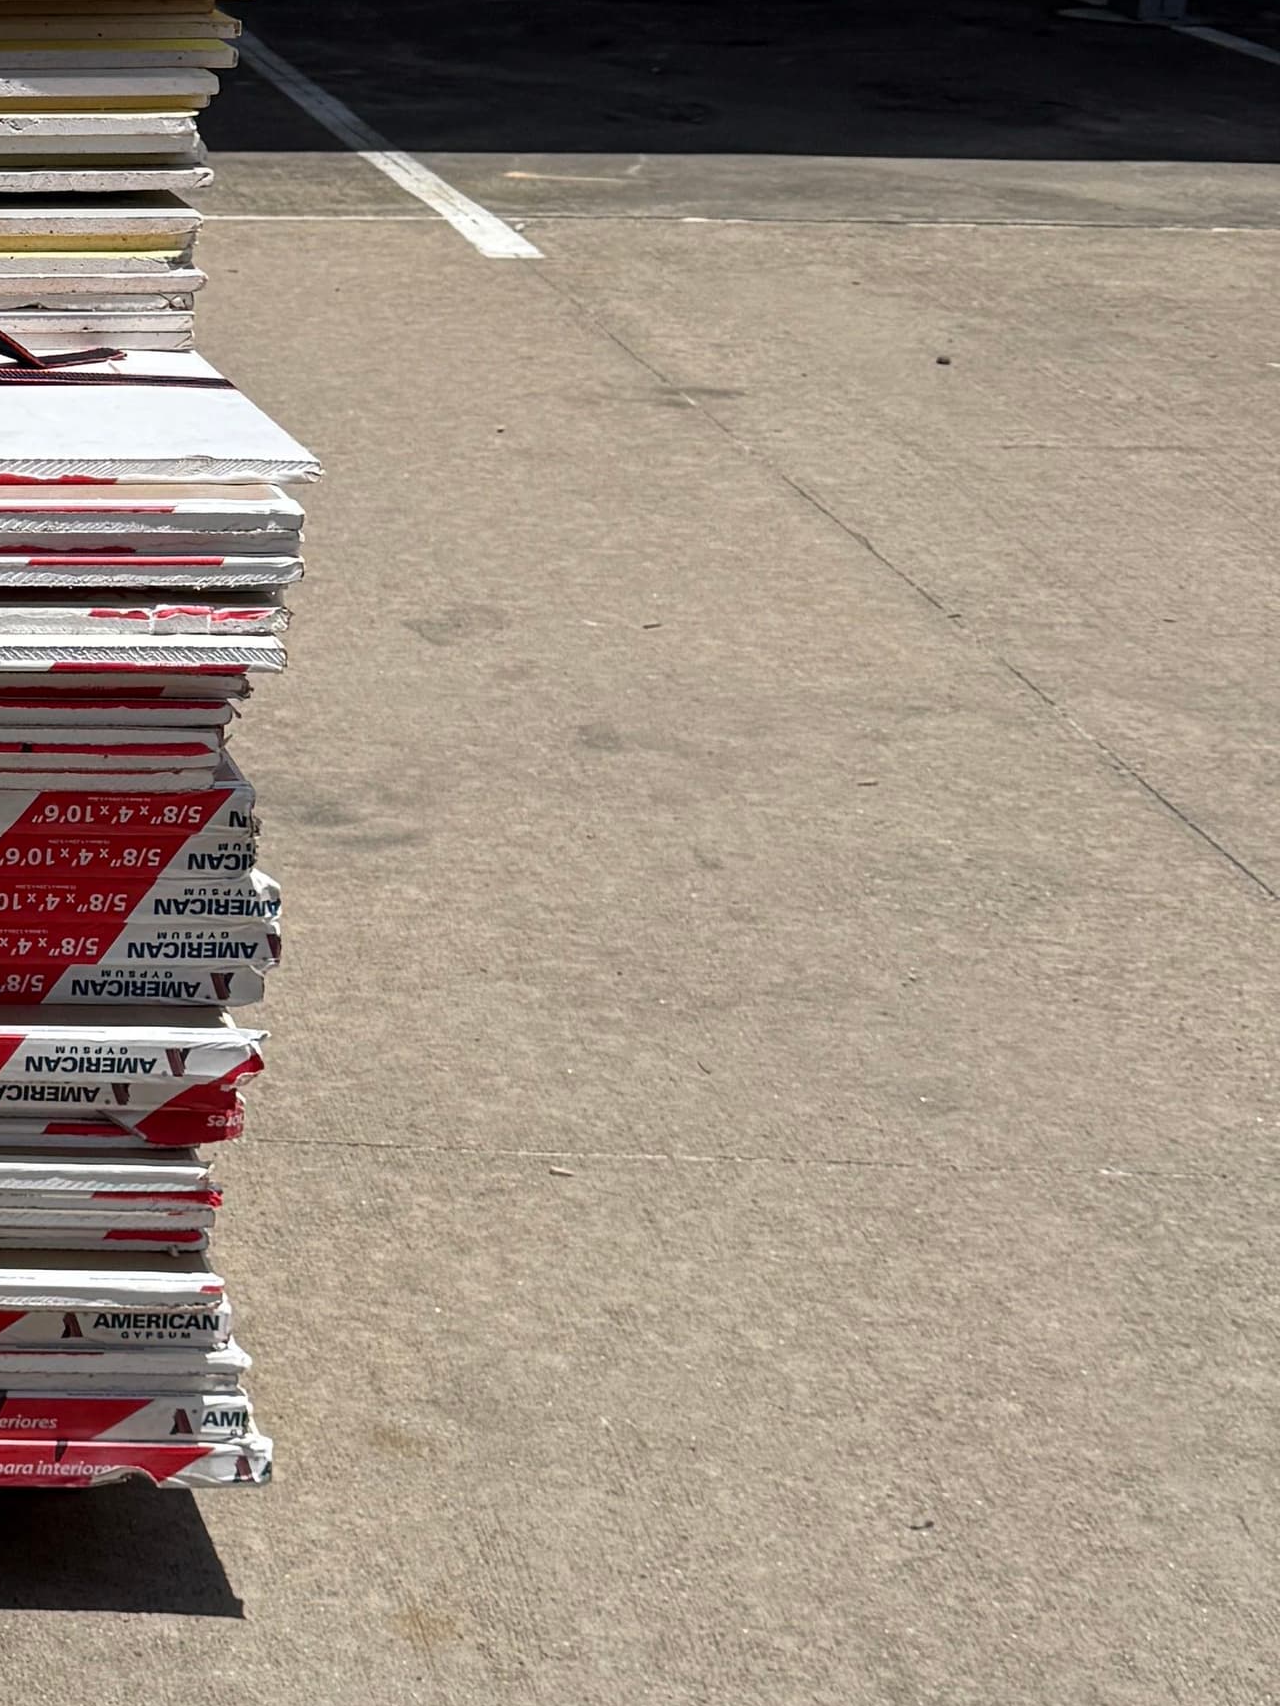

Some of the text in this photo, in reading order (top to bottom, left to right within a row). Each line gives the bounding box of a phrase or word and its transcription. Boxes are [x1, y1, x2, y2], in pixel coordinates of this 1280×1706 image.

[157, 931, 229, 940] GYPSUM
[0, 937, 8, 947] x
[38, 938, 47, 947] x
[127, 942, 259, 959] AMERICAN
[55, 1046, 128, 1055] GYPSUM
[25, 1056, 157, 1074] AMERICAN
[93, 1313, 219, 1331] AMERICAN
[121, 1331, 191, 1339] GYPSUM
